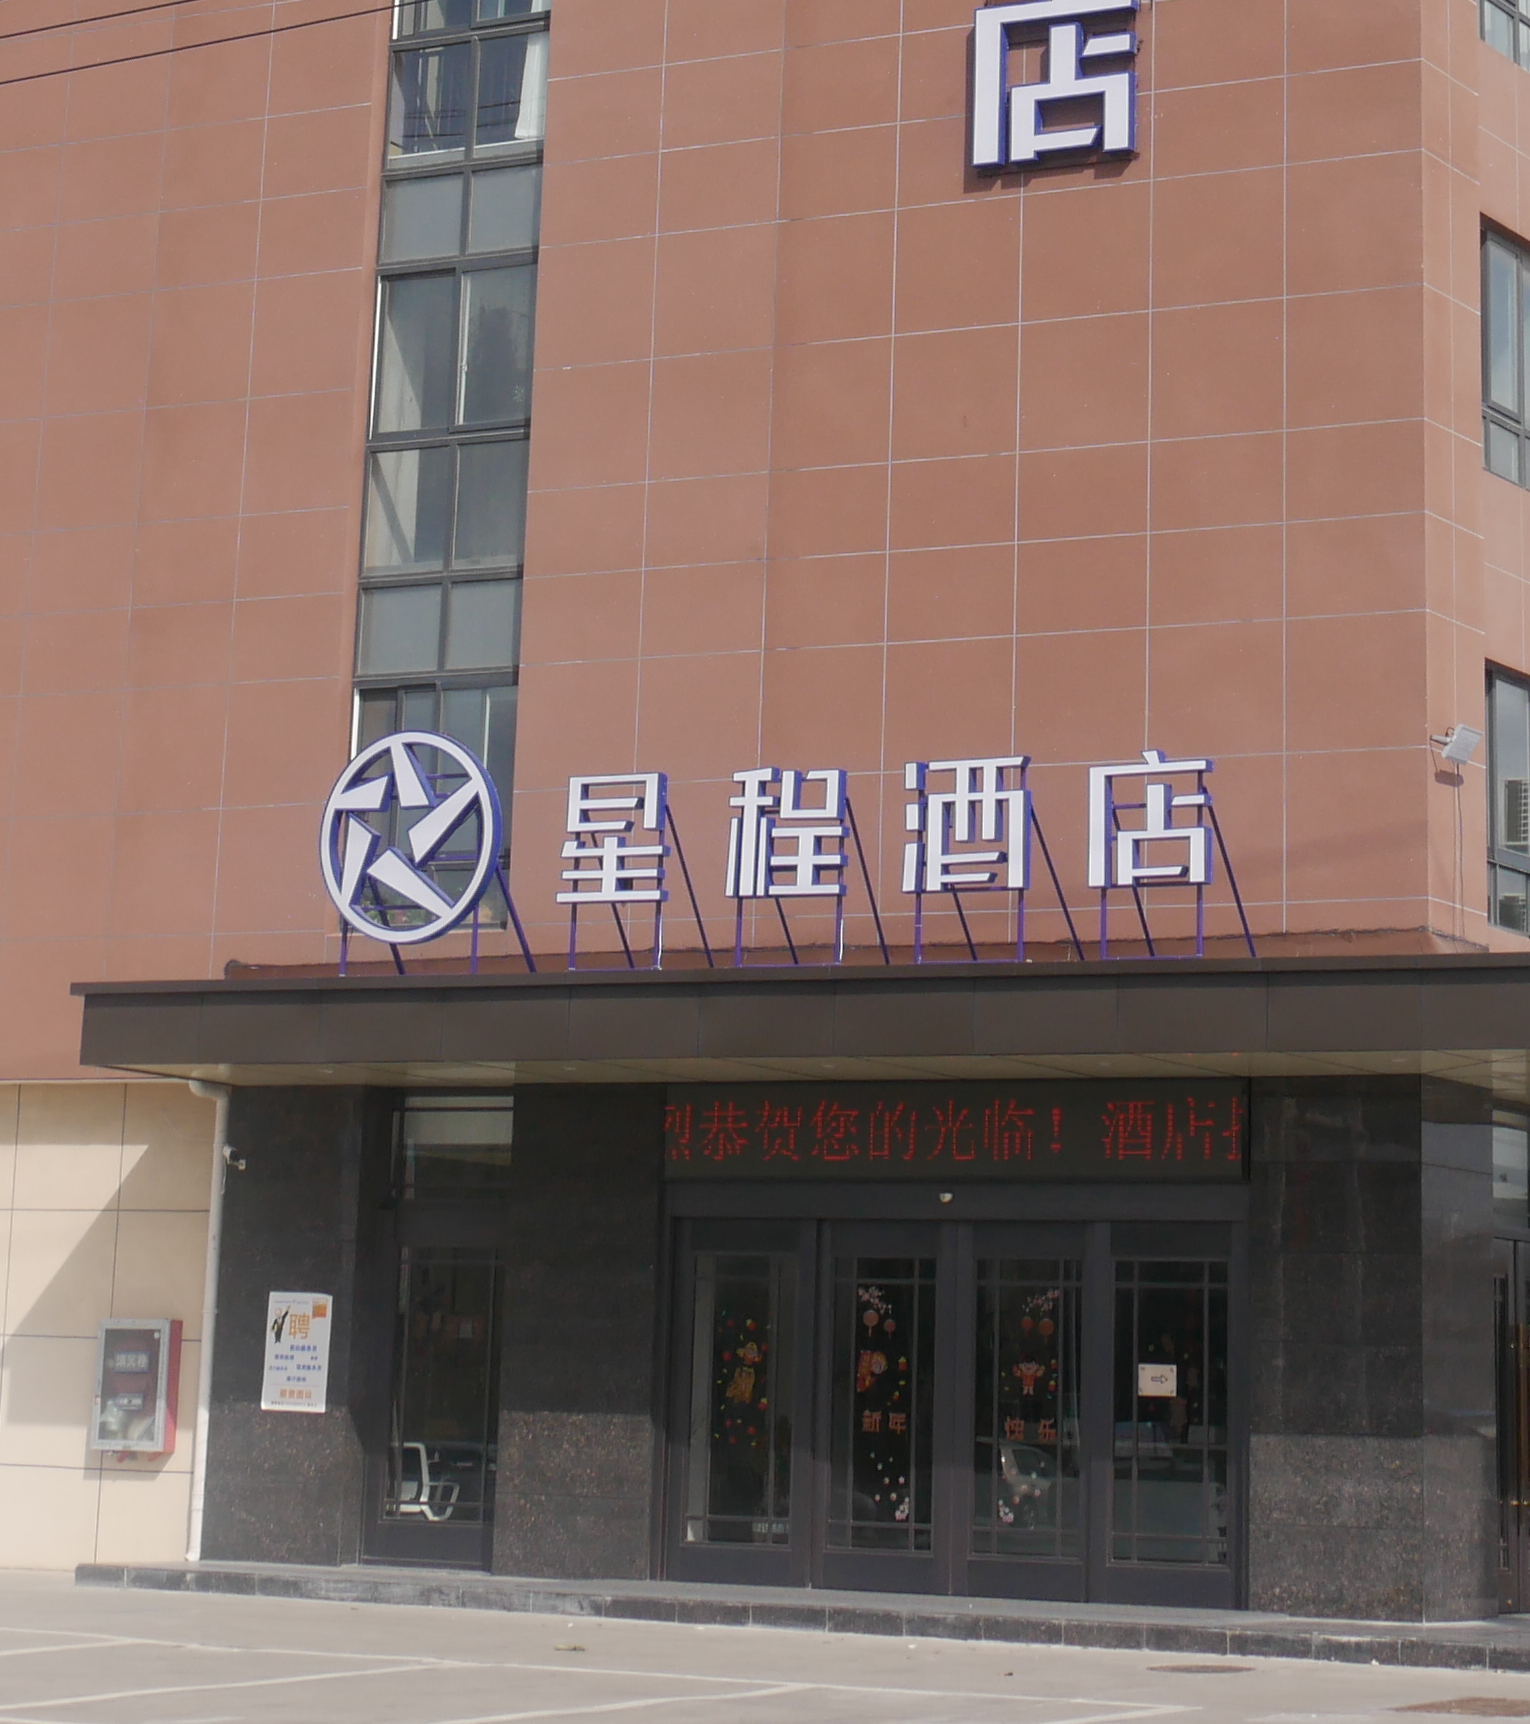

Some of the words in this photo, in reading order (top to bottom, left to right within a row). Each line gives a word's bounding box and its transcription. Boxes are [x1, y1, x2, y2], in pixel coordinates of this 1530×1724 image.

[556, 750, 1213, 904] 星程酒店
[289, 1312, 310, 1340] 聘
